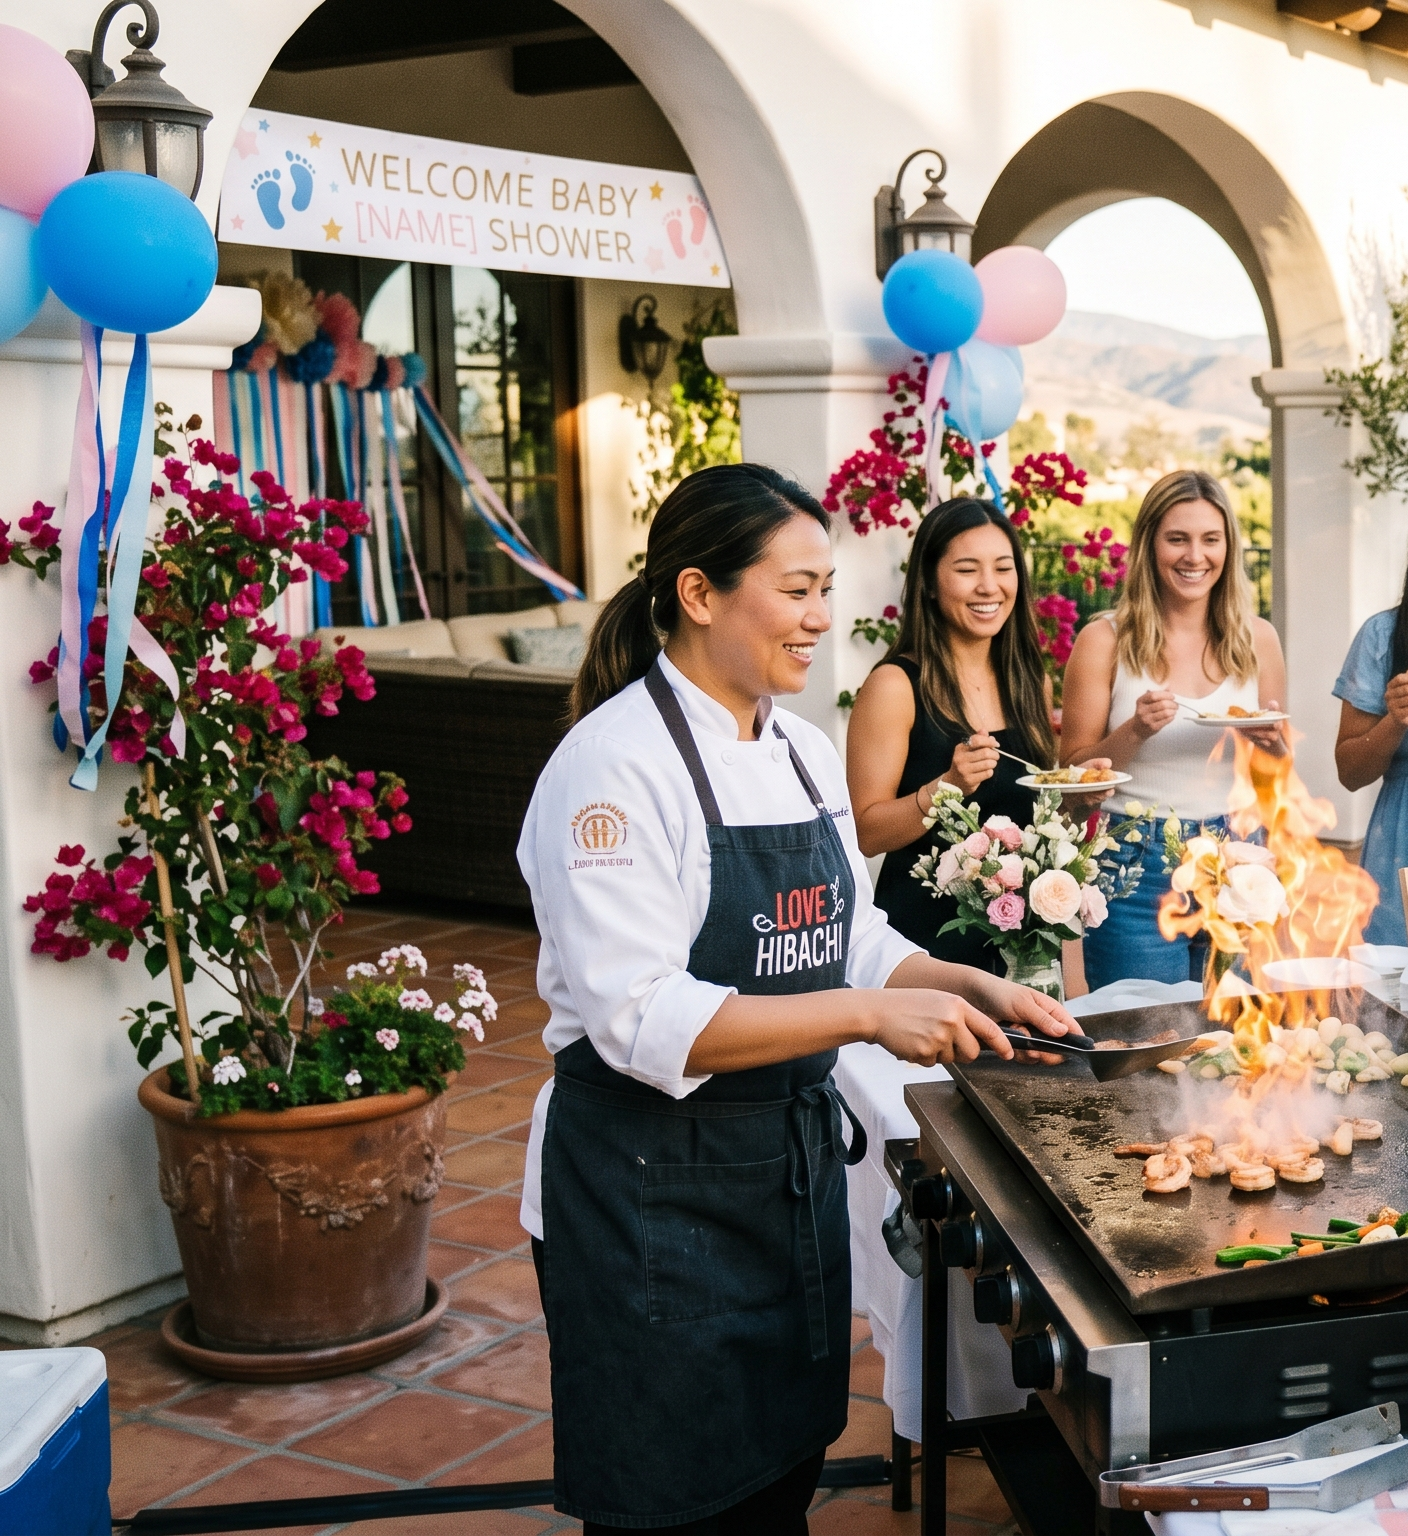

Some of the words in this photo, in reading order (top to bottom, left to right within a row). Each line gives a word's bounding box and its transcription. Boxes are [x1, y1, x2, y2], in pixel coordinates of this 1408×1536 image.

[340, 147, 534, 208] WELCOME
[552, 177, 638, 219] BABY
[355, 200, 478, 255] [NAME]
[490, 218, 635, 264] SHOWER
[775, 884, 827, 932] LOVE
[755, 922, 843, 977] HIBACHI
